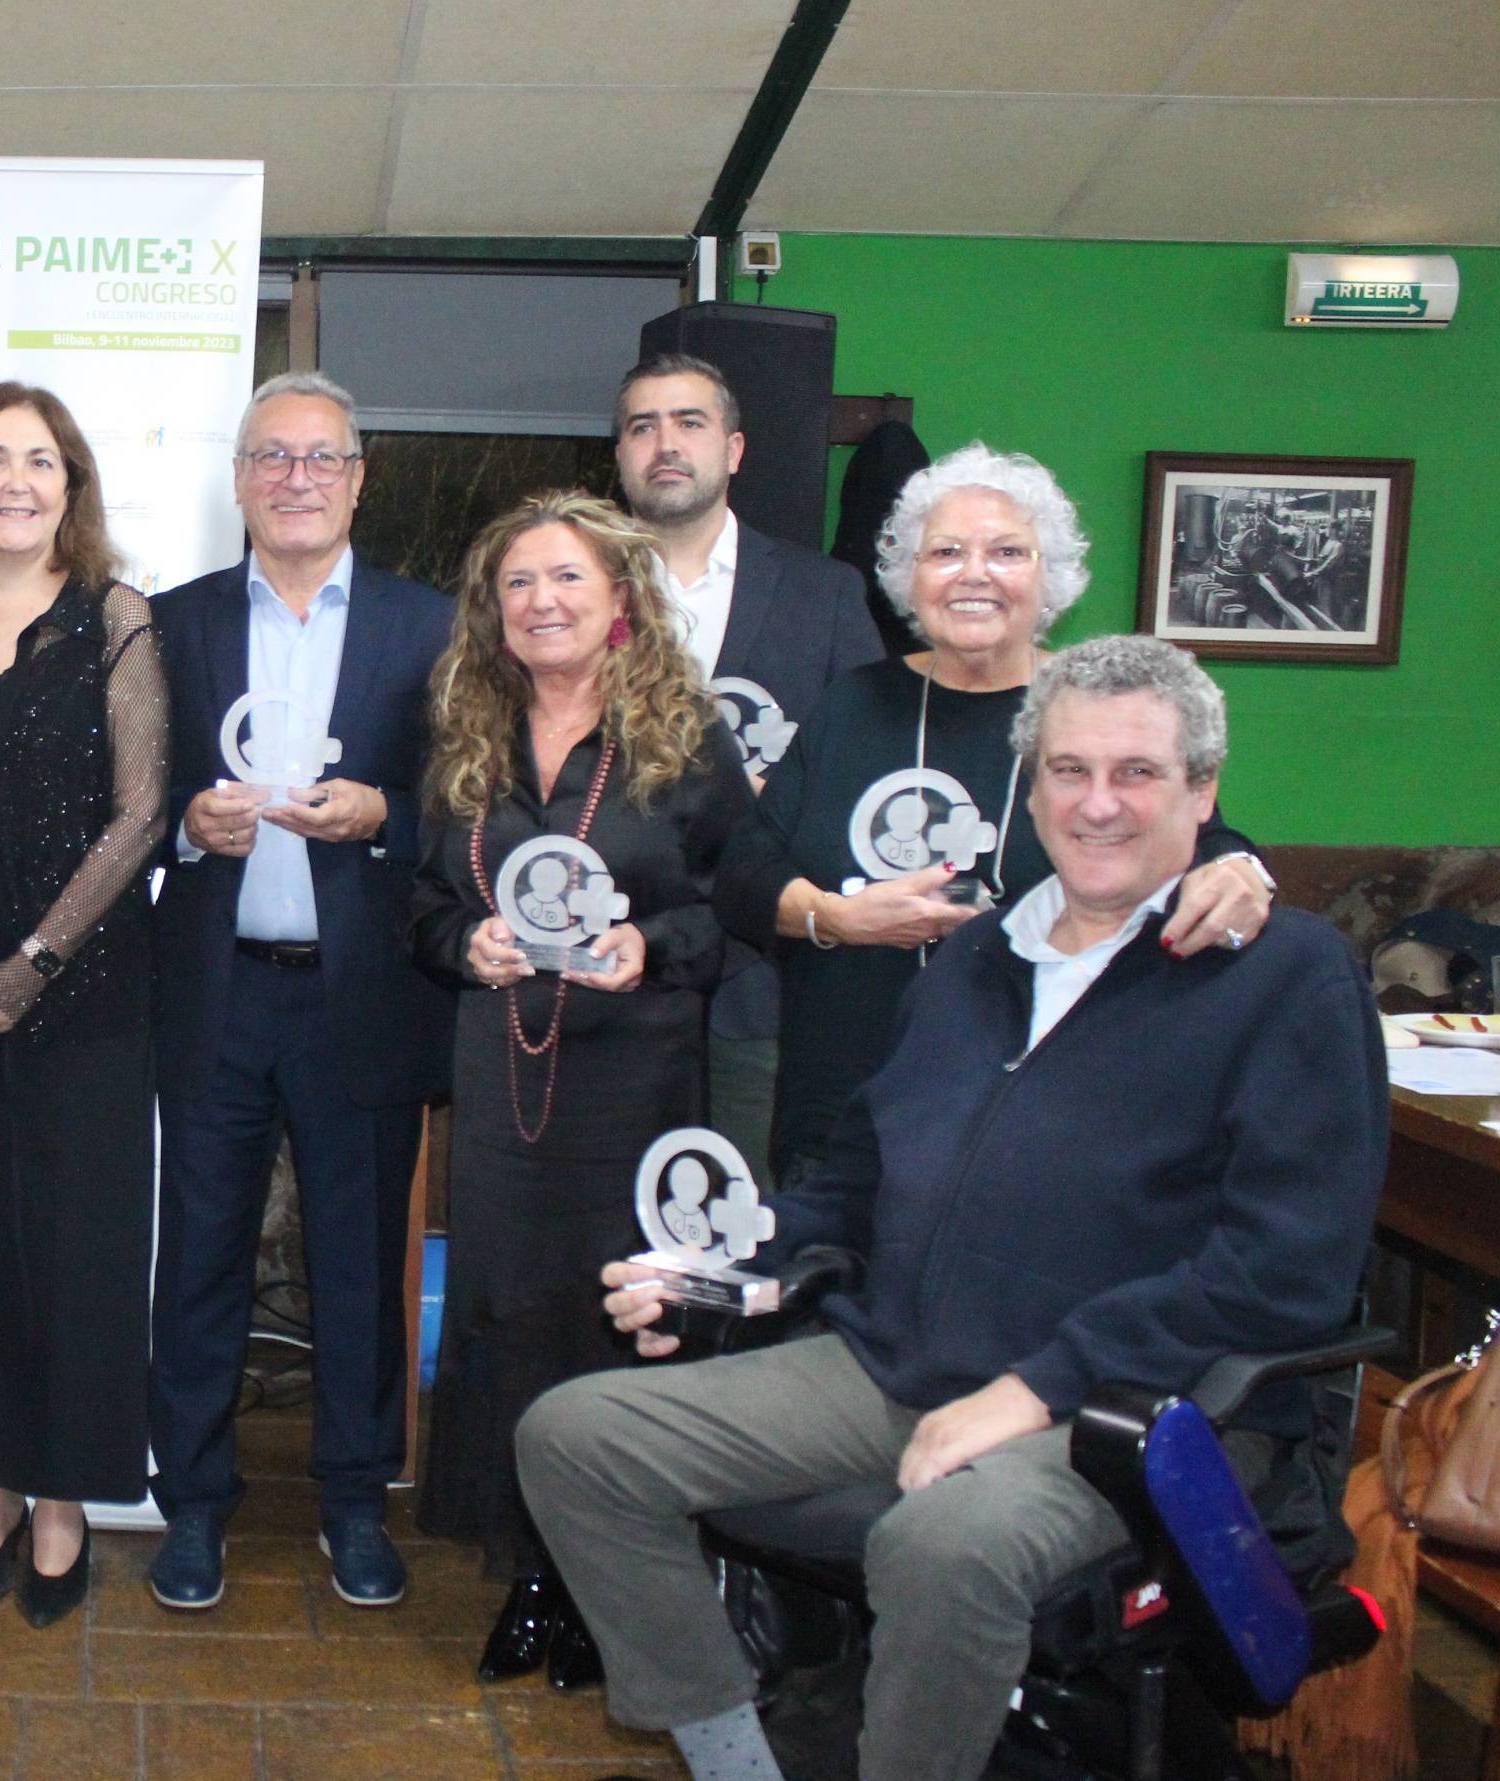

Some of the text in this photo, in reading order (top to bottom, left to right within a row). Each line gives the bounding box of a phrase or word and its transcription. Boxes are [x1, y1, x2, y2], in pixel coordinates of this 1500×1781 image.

[210, 239, 238, 276] X
[96, 281, 237, 306] CONGRESO
[1333, 282, 1413, 299] IRTEERA
[52, 333, 96, 348] Bilbao,
[132, 335, 199, 349] noviembre
[203, 337, 235, 350] 2023
